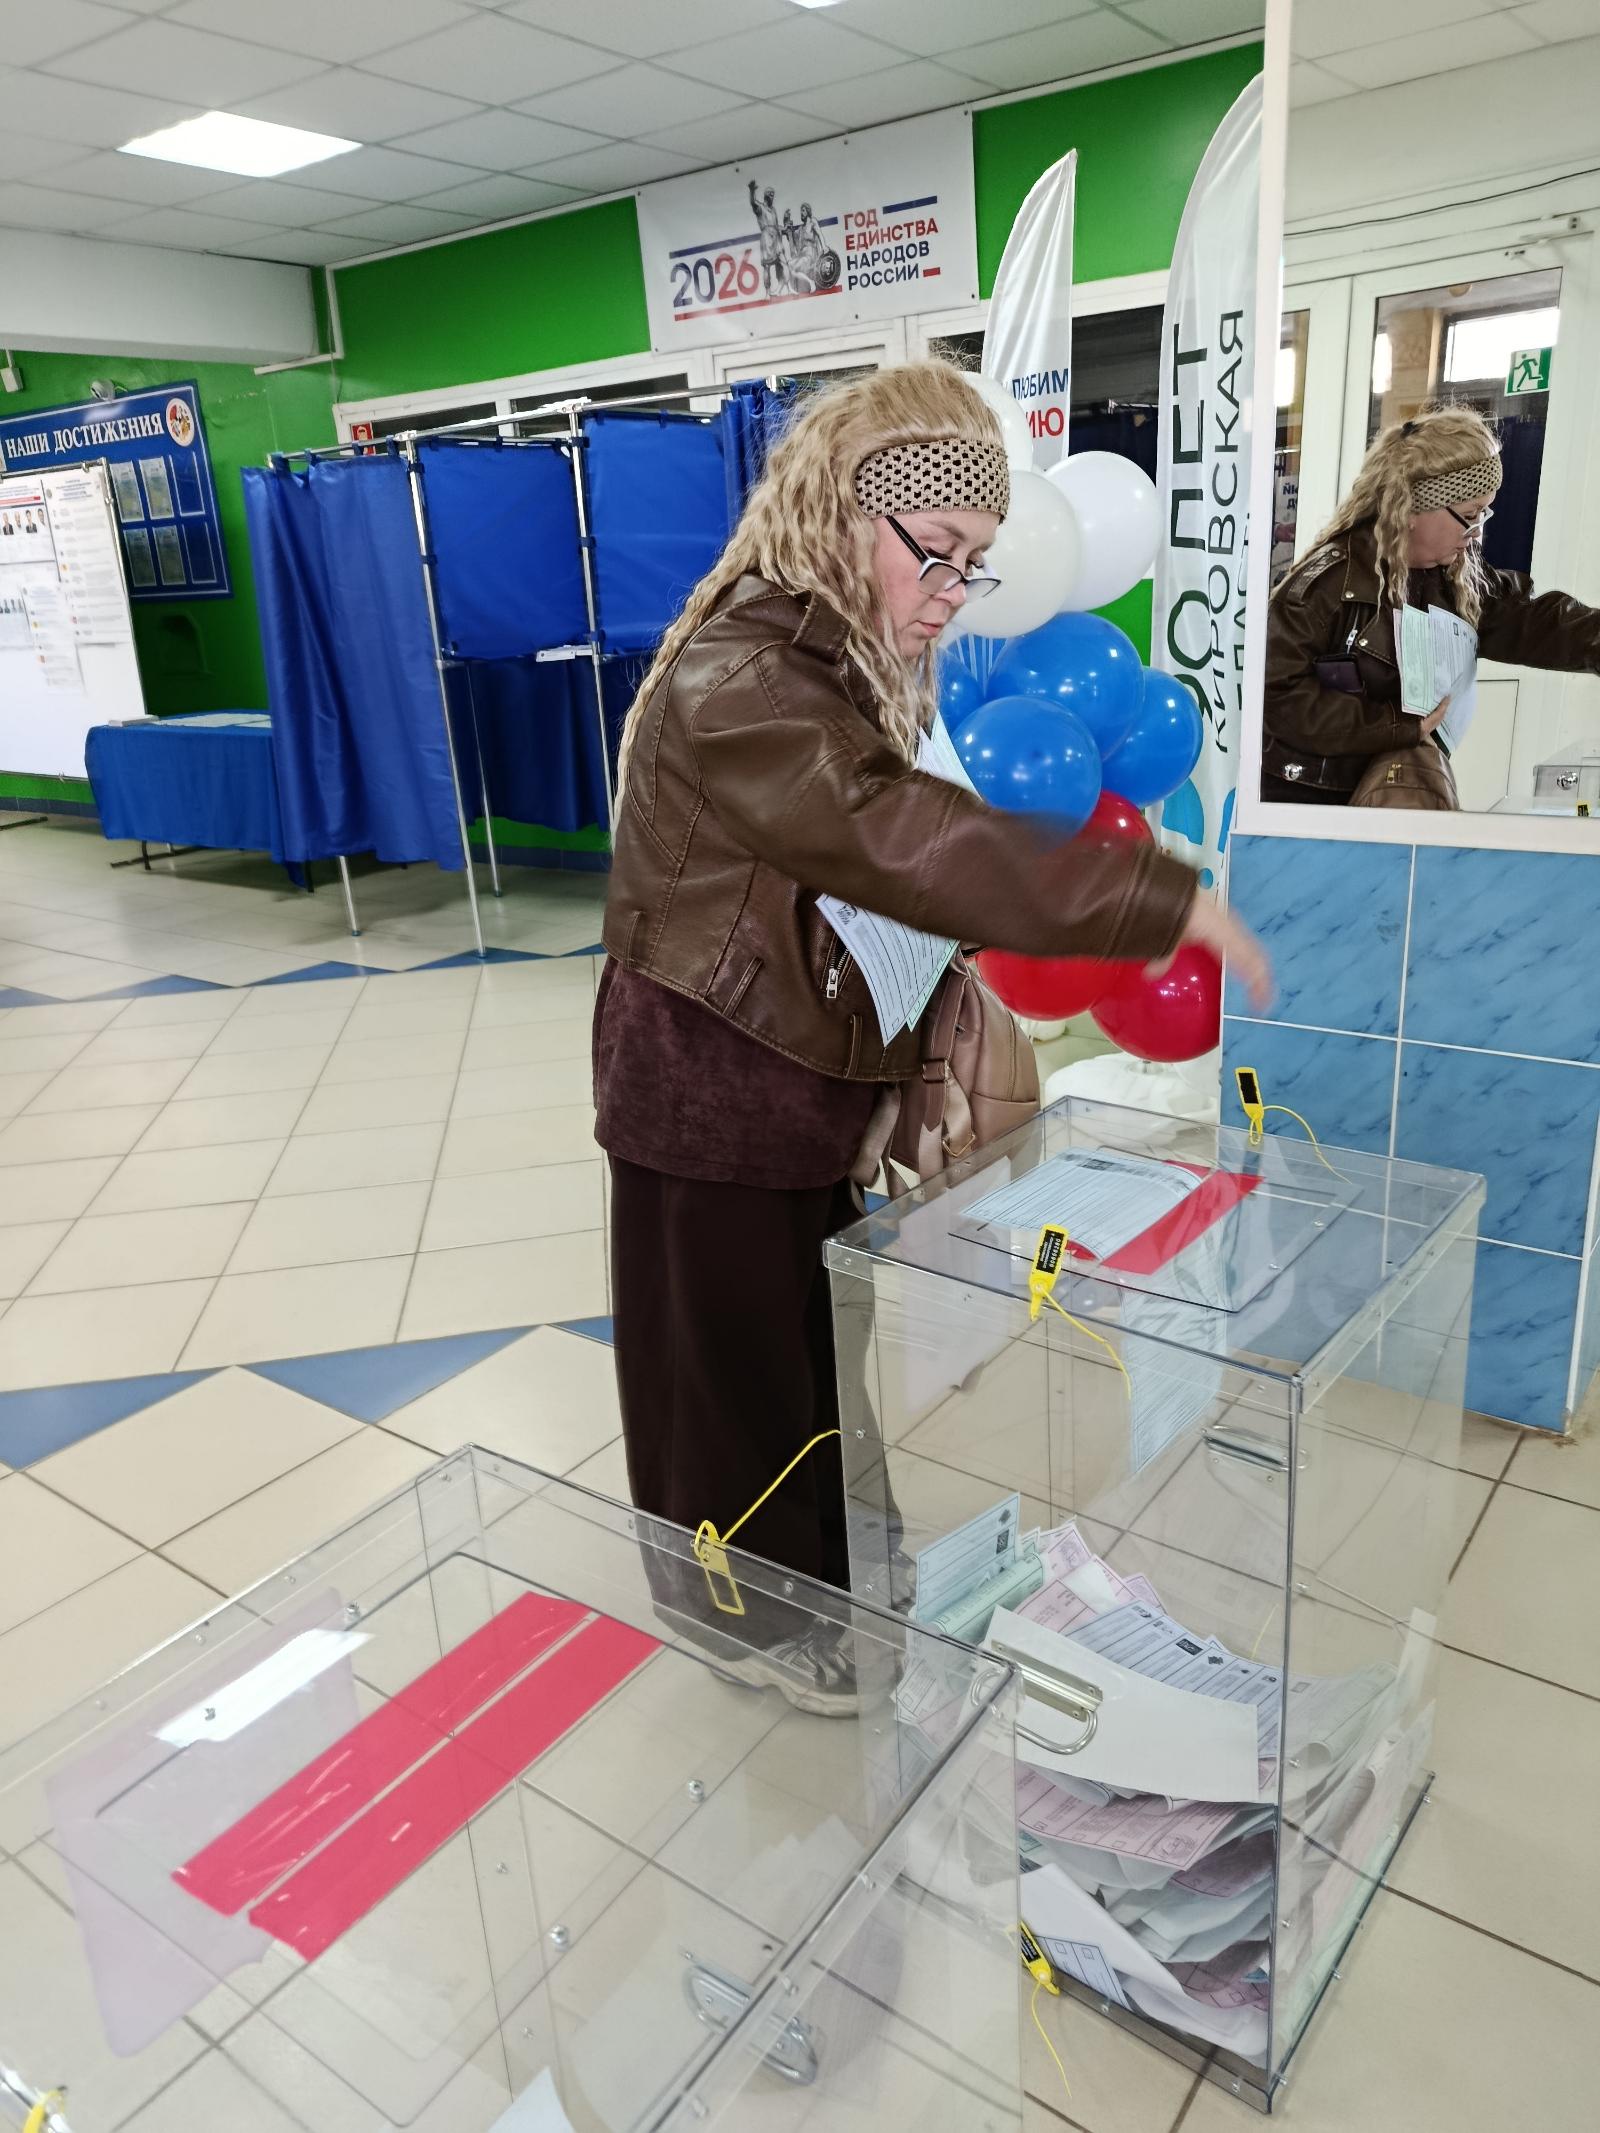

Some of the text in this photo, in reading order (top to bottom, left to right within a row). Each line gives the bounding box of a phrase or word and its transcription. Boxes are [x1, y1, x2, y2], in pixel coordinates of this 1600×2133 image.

[843, 208, 878, 231] ГОД
[845, 217, 939, 251] ЕДИНСТВА
[846, 240, 930, 271] НАРОДОВ
[669, 248, 760, 308] 2026
[848, 263, 919, 291] РОССИИ
[1011, 367, 1069, 401] ЛЮБИМ
[5, 412, 166, 459] НАШИ ДОСТИЖЕНИЯ
[1170, 323, 1208, 552] ЛЕТ
[1206, 309, 1244, 753] КИРОВСКАЯ
